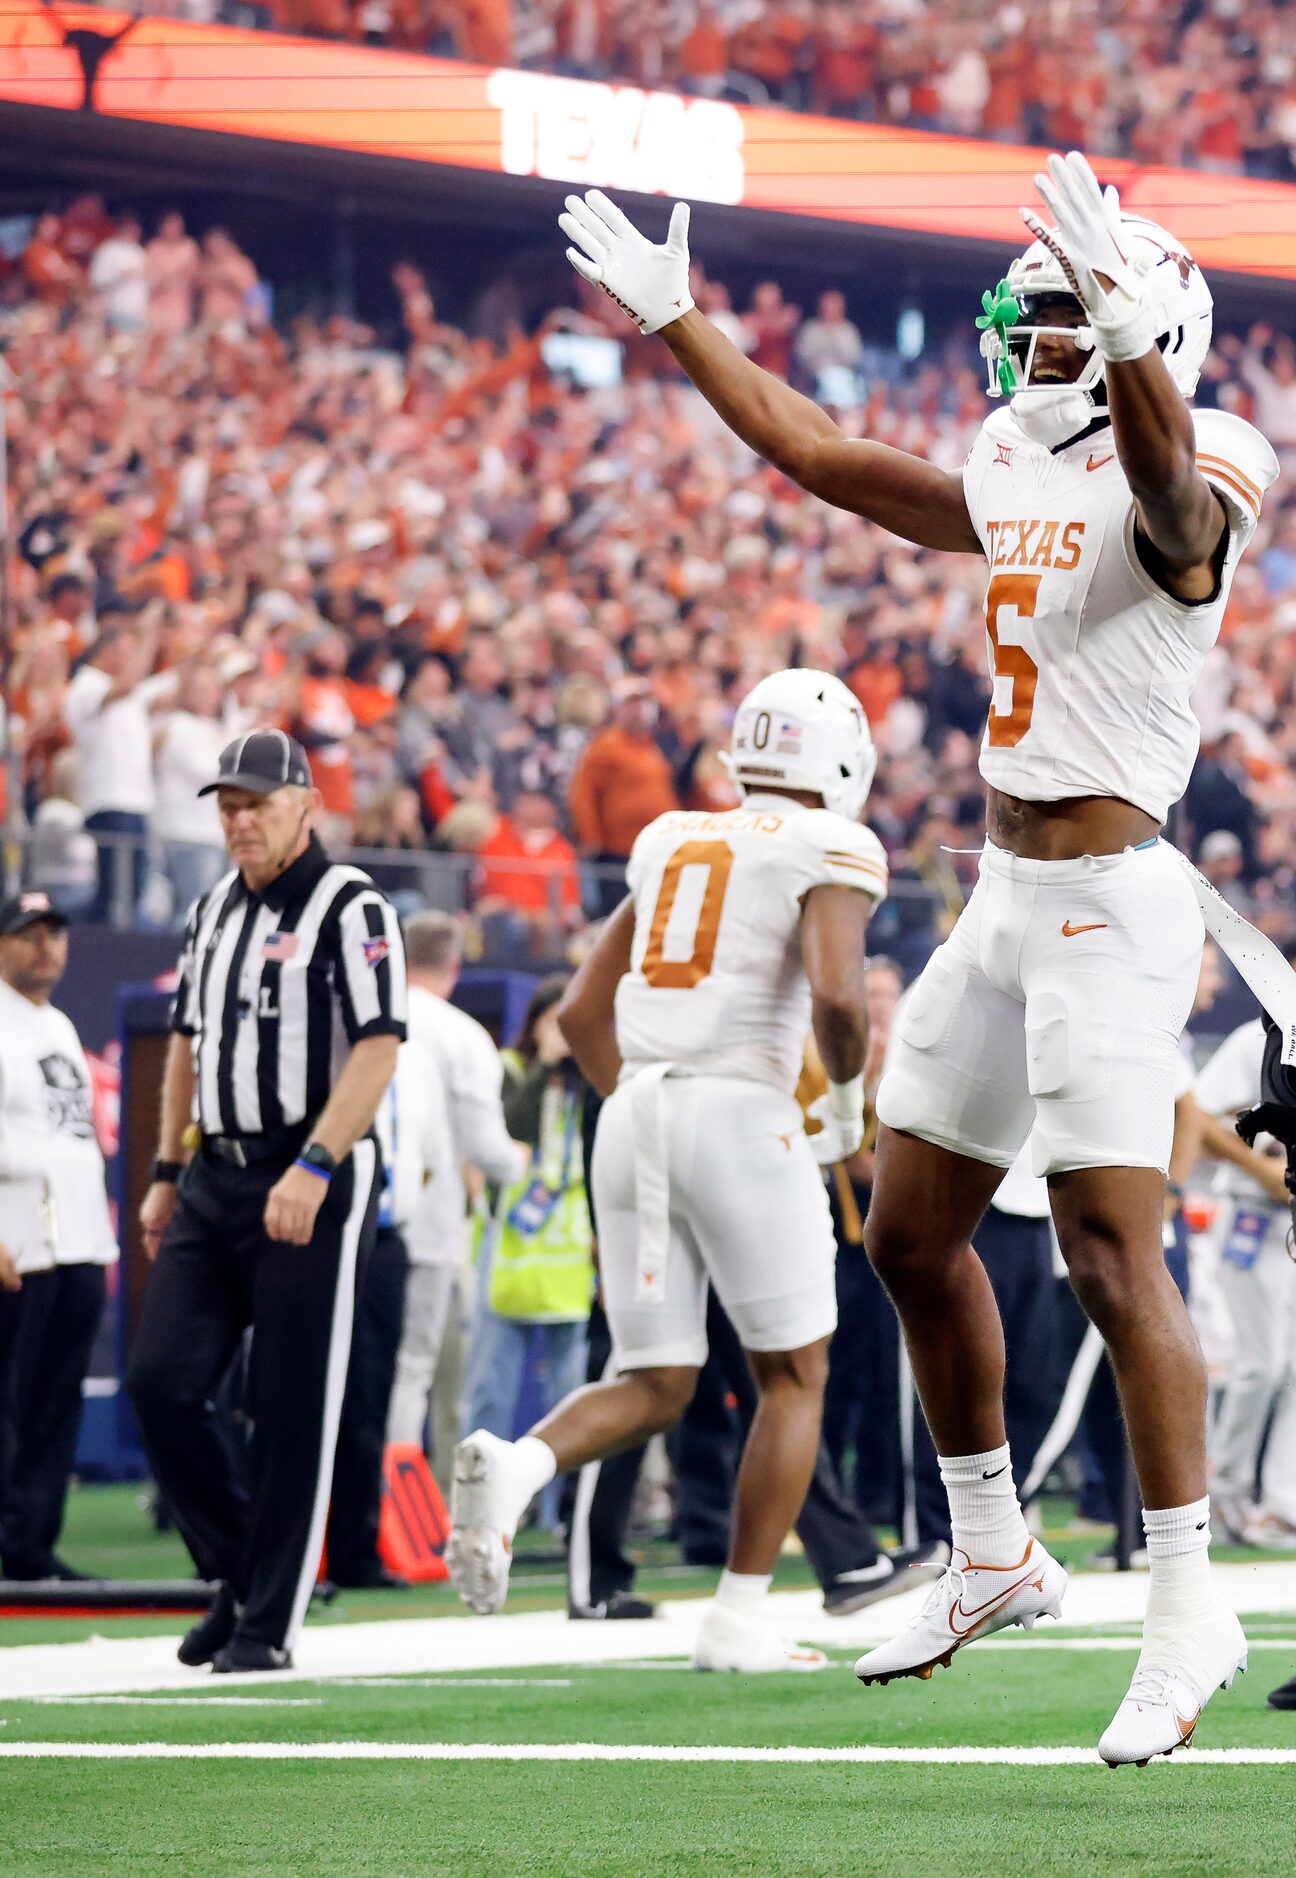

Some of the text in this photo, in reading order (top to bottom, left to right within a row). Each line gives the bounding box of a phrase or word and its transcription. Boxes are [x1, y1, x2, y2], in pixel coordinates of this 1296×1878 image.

[986, 519, 1086, 571] TEXAS
[986, 573, 1042, 748] 5
[753, 711, 771, 751] 0
[641, 840, 735, 989] 0
